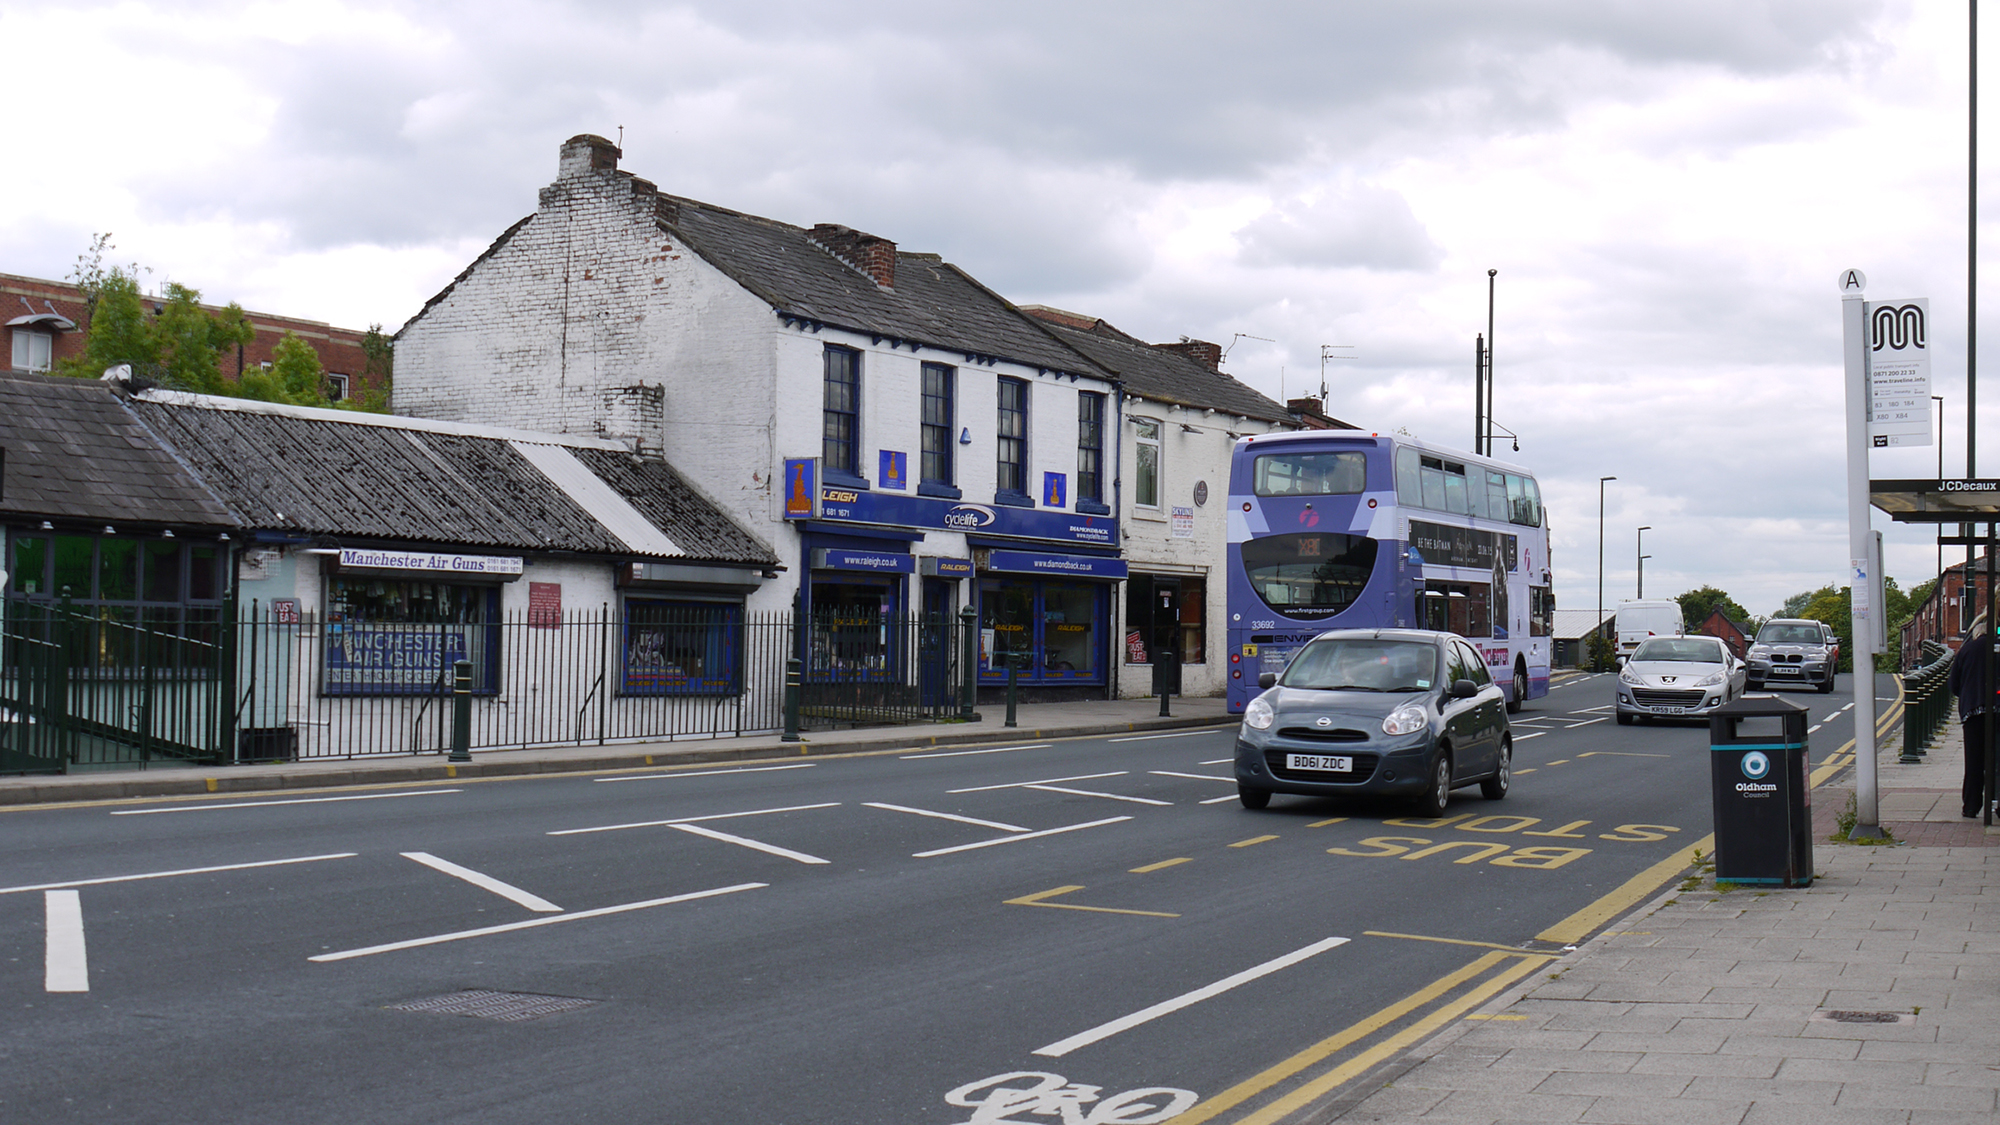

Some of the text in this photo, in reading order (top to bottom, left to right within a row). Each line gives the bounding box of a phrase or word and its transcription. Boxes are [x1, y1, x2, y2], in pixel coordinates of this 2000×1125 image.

[1845, 270, 1860, 289] A
[1873, 376, 1926, 384] www.traveline.info
[1938, 480, 1997, 491] JCDecaux
[826, 507, 836, 516] 681
[838, 508, 850, 517] 1671
[944, 512, 978, 528] cyclelife
[1069, 525, 1109, 535] DIAMONDBACK
[1417, 537, 1424, 548] BE
[1424, 538, 1432, 549] THE
[1433, 539, 1451, 551] BATMAN
[342, 550, 485, 571] Manchester Air Guns
[844, 555, 898, 568] www.raleigh.co.uk
[1034, 559, 1093, 571] www.diamondback.co.uk
[940, 563, 971, 572] RALEIGH
[275, 602, 294, 612] JUST
[1284, 607, 1335, 615] www.firstgroup.com
[995, 624, 1024, 632] RALEIGH
[1251, 620, 1275, 629] 33692
[352, 650, 442, 668] AIR GUNS
[1293, 756, 1345, 769] BD61 ZDC
[1735, 783, 1777, 792] Oldham
[1382, 813, 1681, 842] STOP
[1326, 836, 1594, 870] BUS
